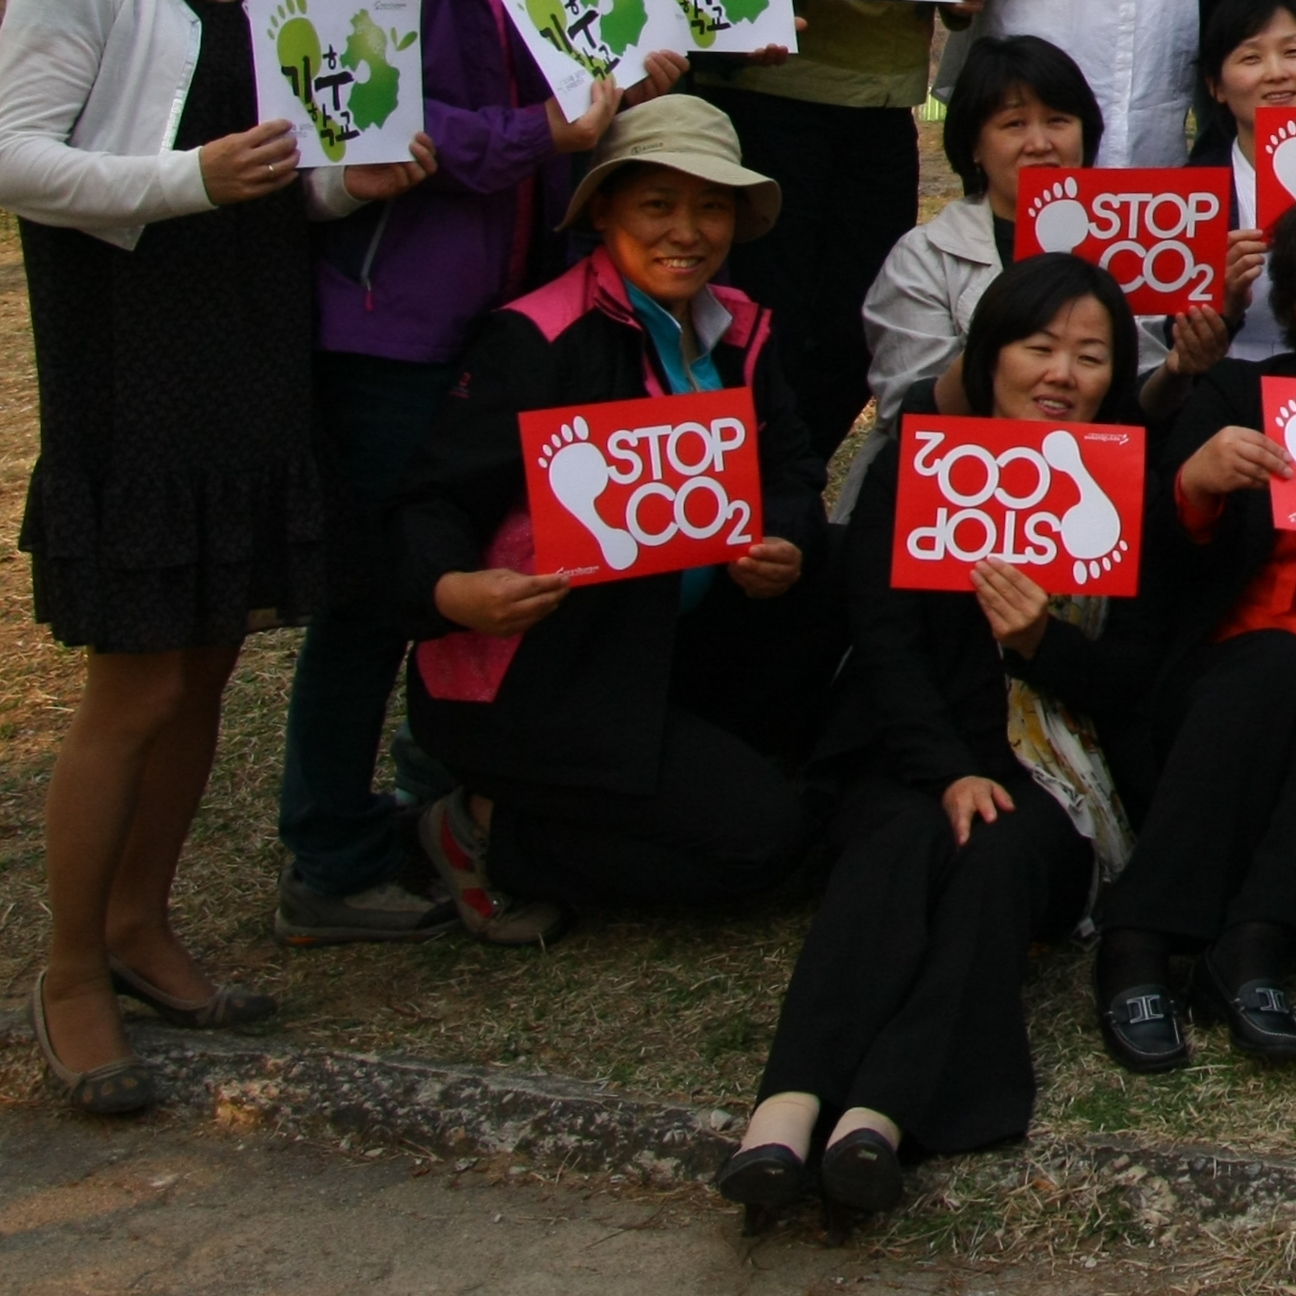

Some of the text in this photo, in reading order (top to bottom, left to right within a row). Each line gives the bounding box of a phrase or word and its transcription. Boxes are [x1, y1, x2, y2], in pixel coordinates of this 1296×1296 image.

[683, 0, 731, 35] 학교
[282, 45, 354, 111] 기후
[308, 104, 360, 146] 학교
[1089, 192, 1219, 240] STOP
[606, 416, 745, 484] STOP
[906, 508, 1062, 565] STOP
